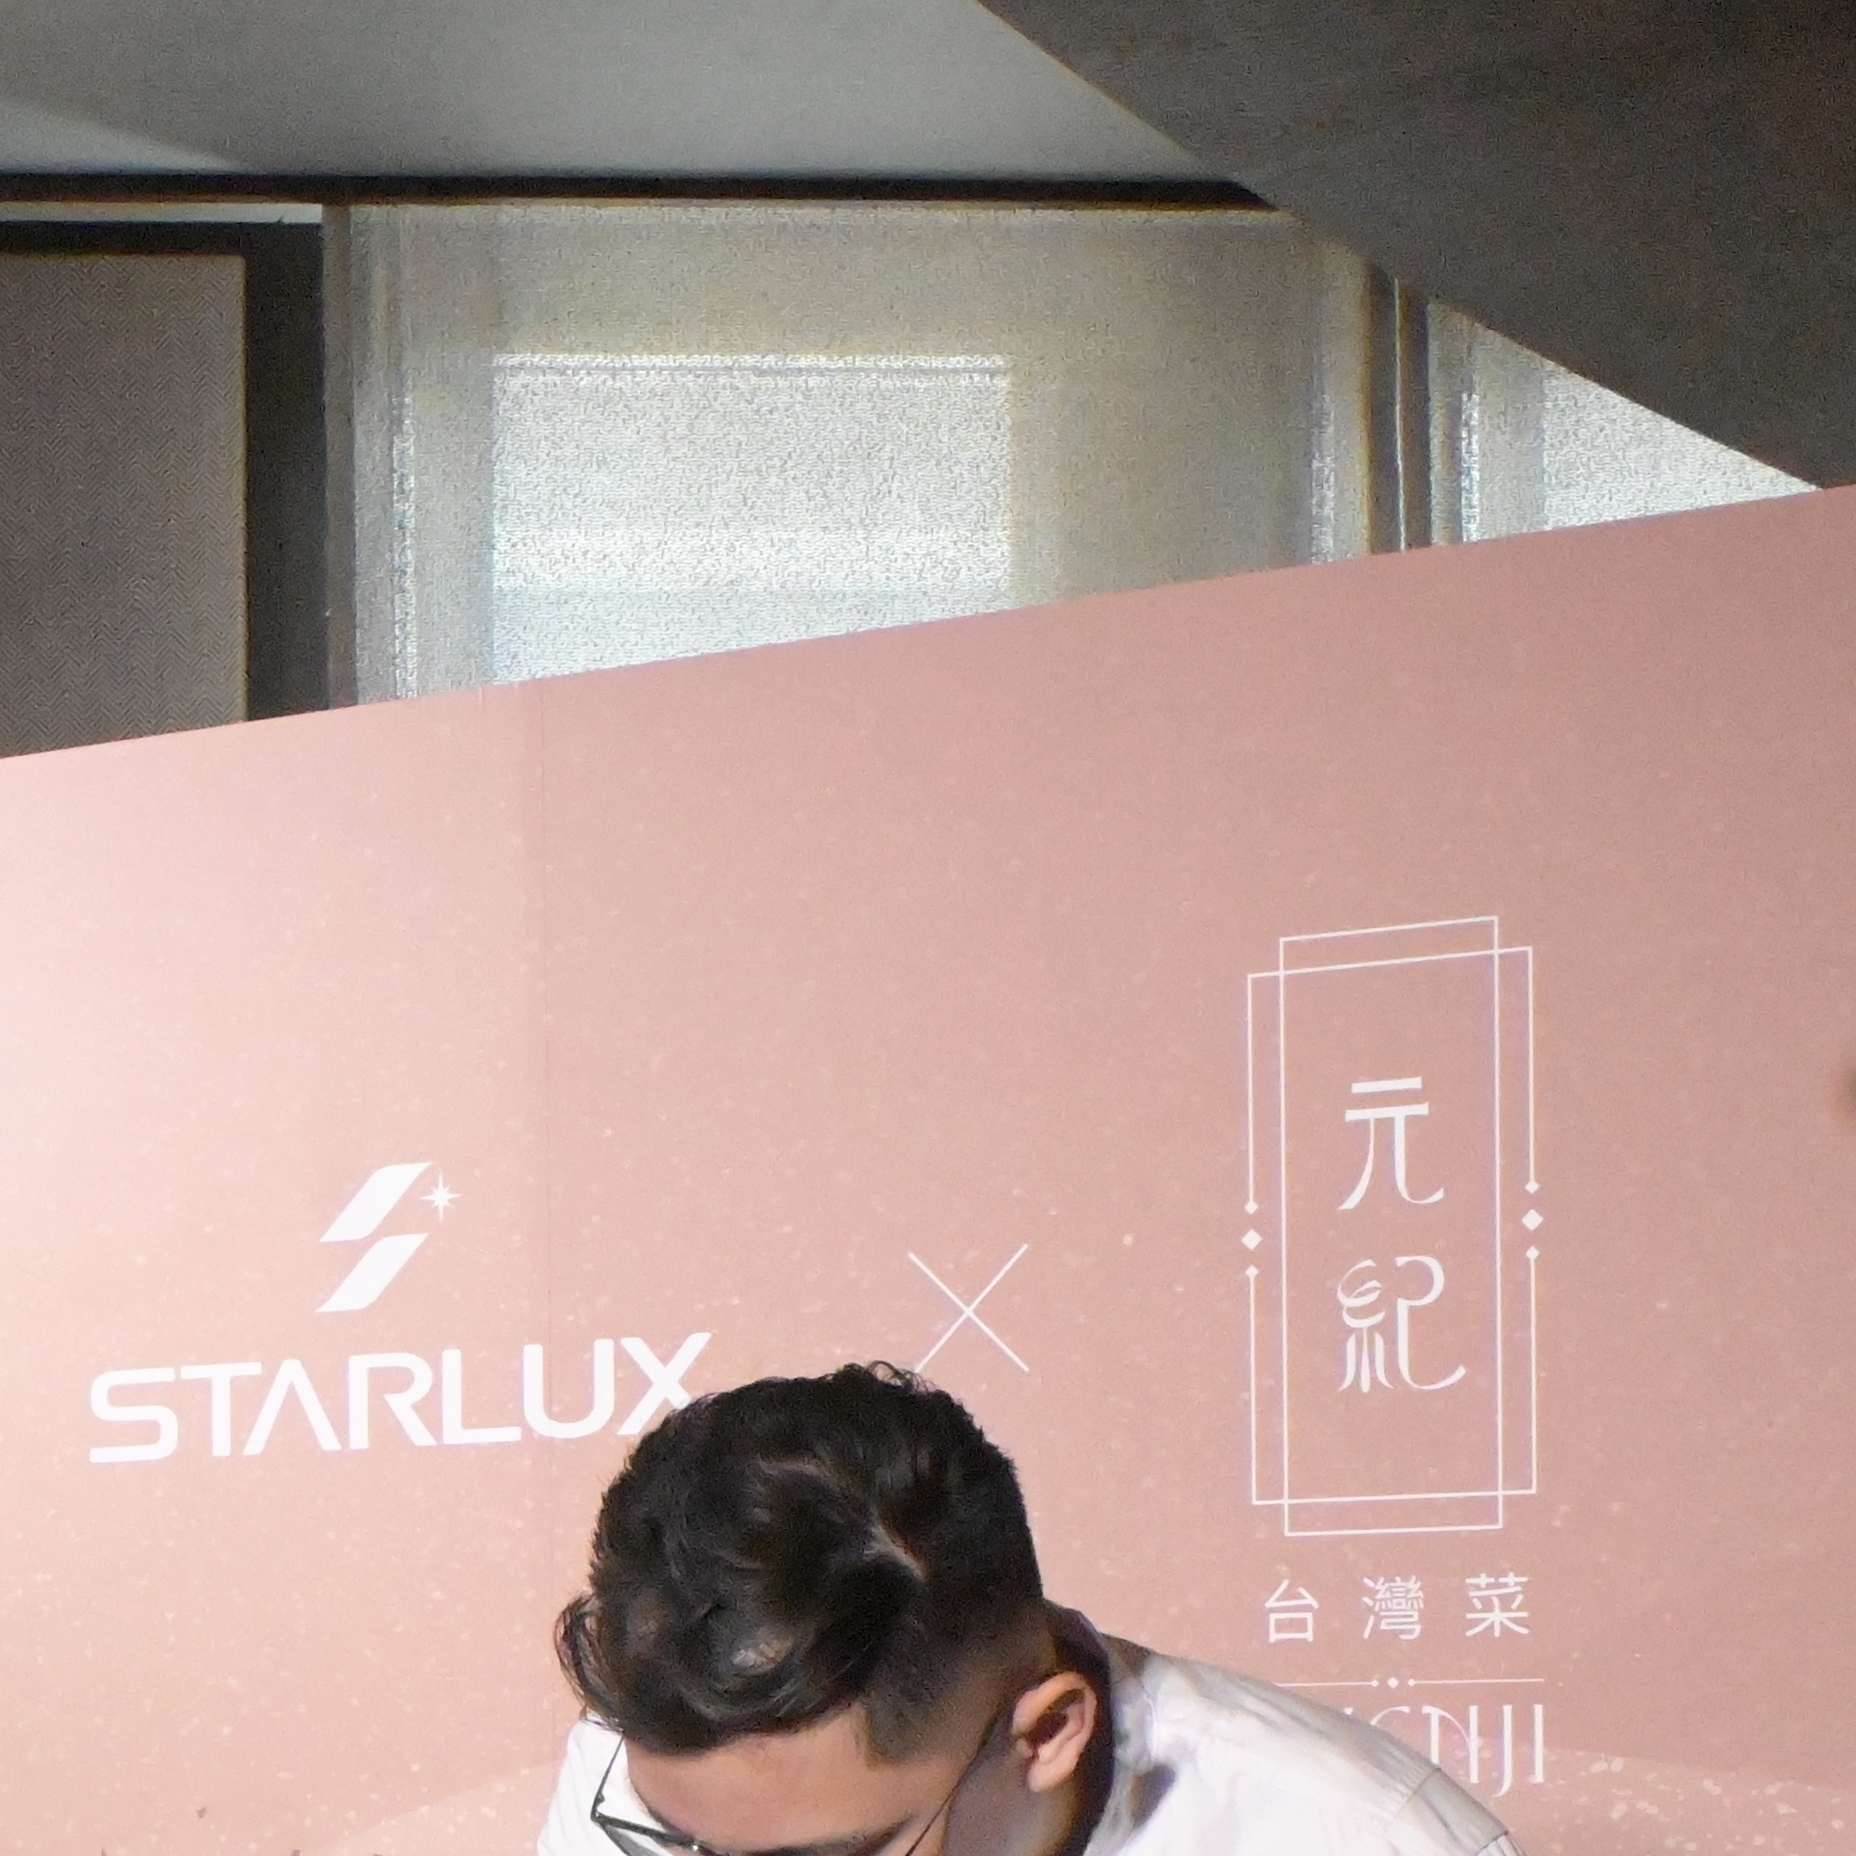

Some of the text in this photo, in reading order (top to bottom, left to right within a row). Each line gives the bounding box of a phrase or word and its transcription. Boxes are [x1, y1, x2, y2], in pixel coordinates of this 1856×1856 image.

[1338, 1076, 1466, 1393] 元紀
[89, 1332, 712, 1463] STARLUX
[1264, 1573, 1530, 1643] 台灣菜
